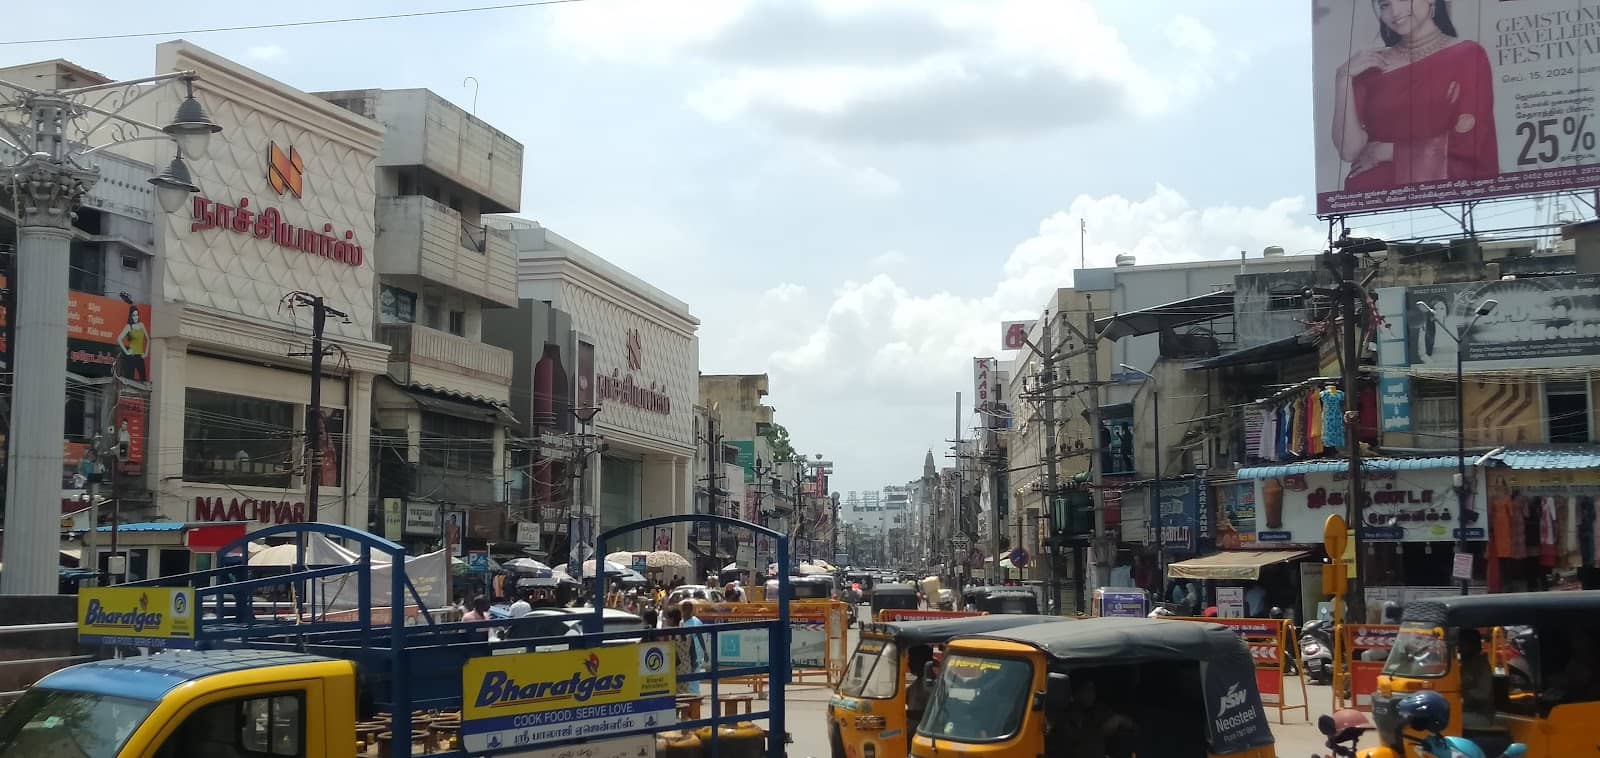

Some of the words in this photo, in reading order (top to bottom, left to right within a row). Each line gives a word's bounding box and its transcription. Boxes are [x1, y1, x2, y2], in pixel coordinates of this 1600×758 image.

[1546, 67, 1575, 78] 2024
[191, 196, 363, 266] நாச்சியார்ஸ்
[85, 599, 163, 632] Bharatgas
[475, 670, 626, 708] Bharatgas
[1217, 689, 1247, 717] JSW
[513, 715, 542, 728] COOK
[576, 705, 608, 719] SERVE
[1215, 704, 1257, 734] Neosteel
[532, 724, 573, 741] பாலாஜி
